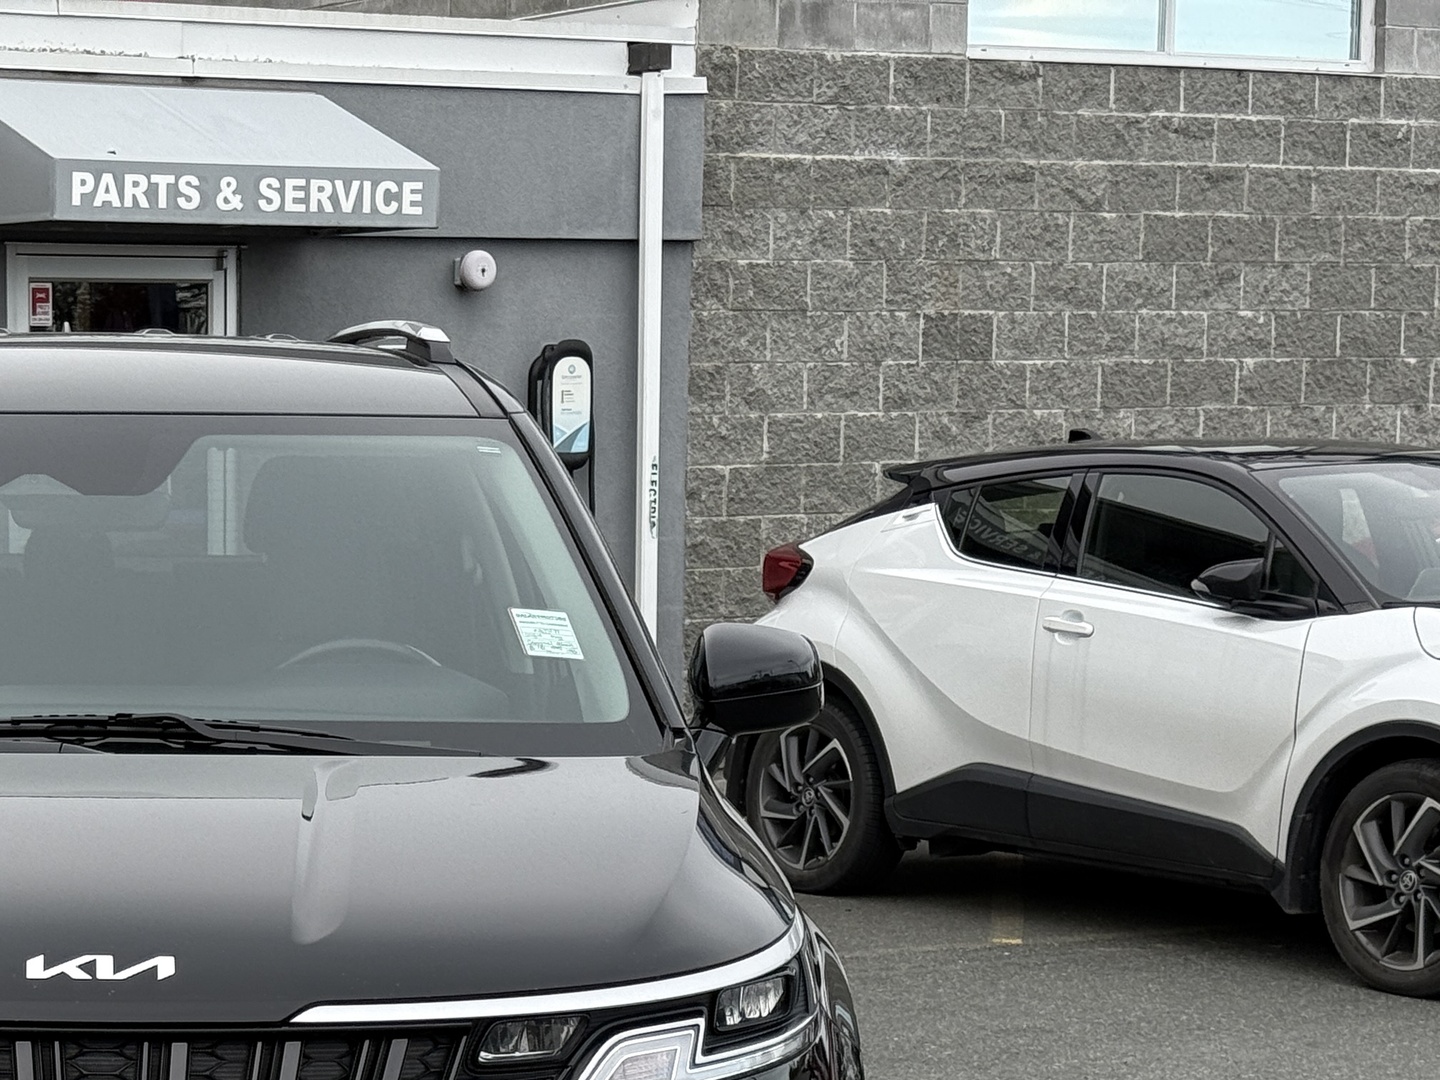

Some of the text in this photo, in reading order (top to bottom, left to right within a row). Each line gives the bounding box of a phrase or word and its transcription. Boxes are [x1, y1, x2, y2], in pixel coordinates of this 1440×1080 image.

[71, 171, 424, 215] PARTS & SERVICE
[26, 954, 176, 981] KIA
